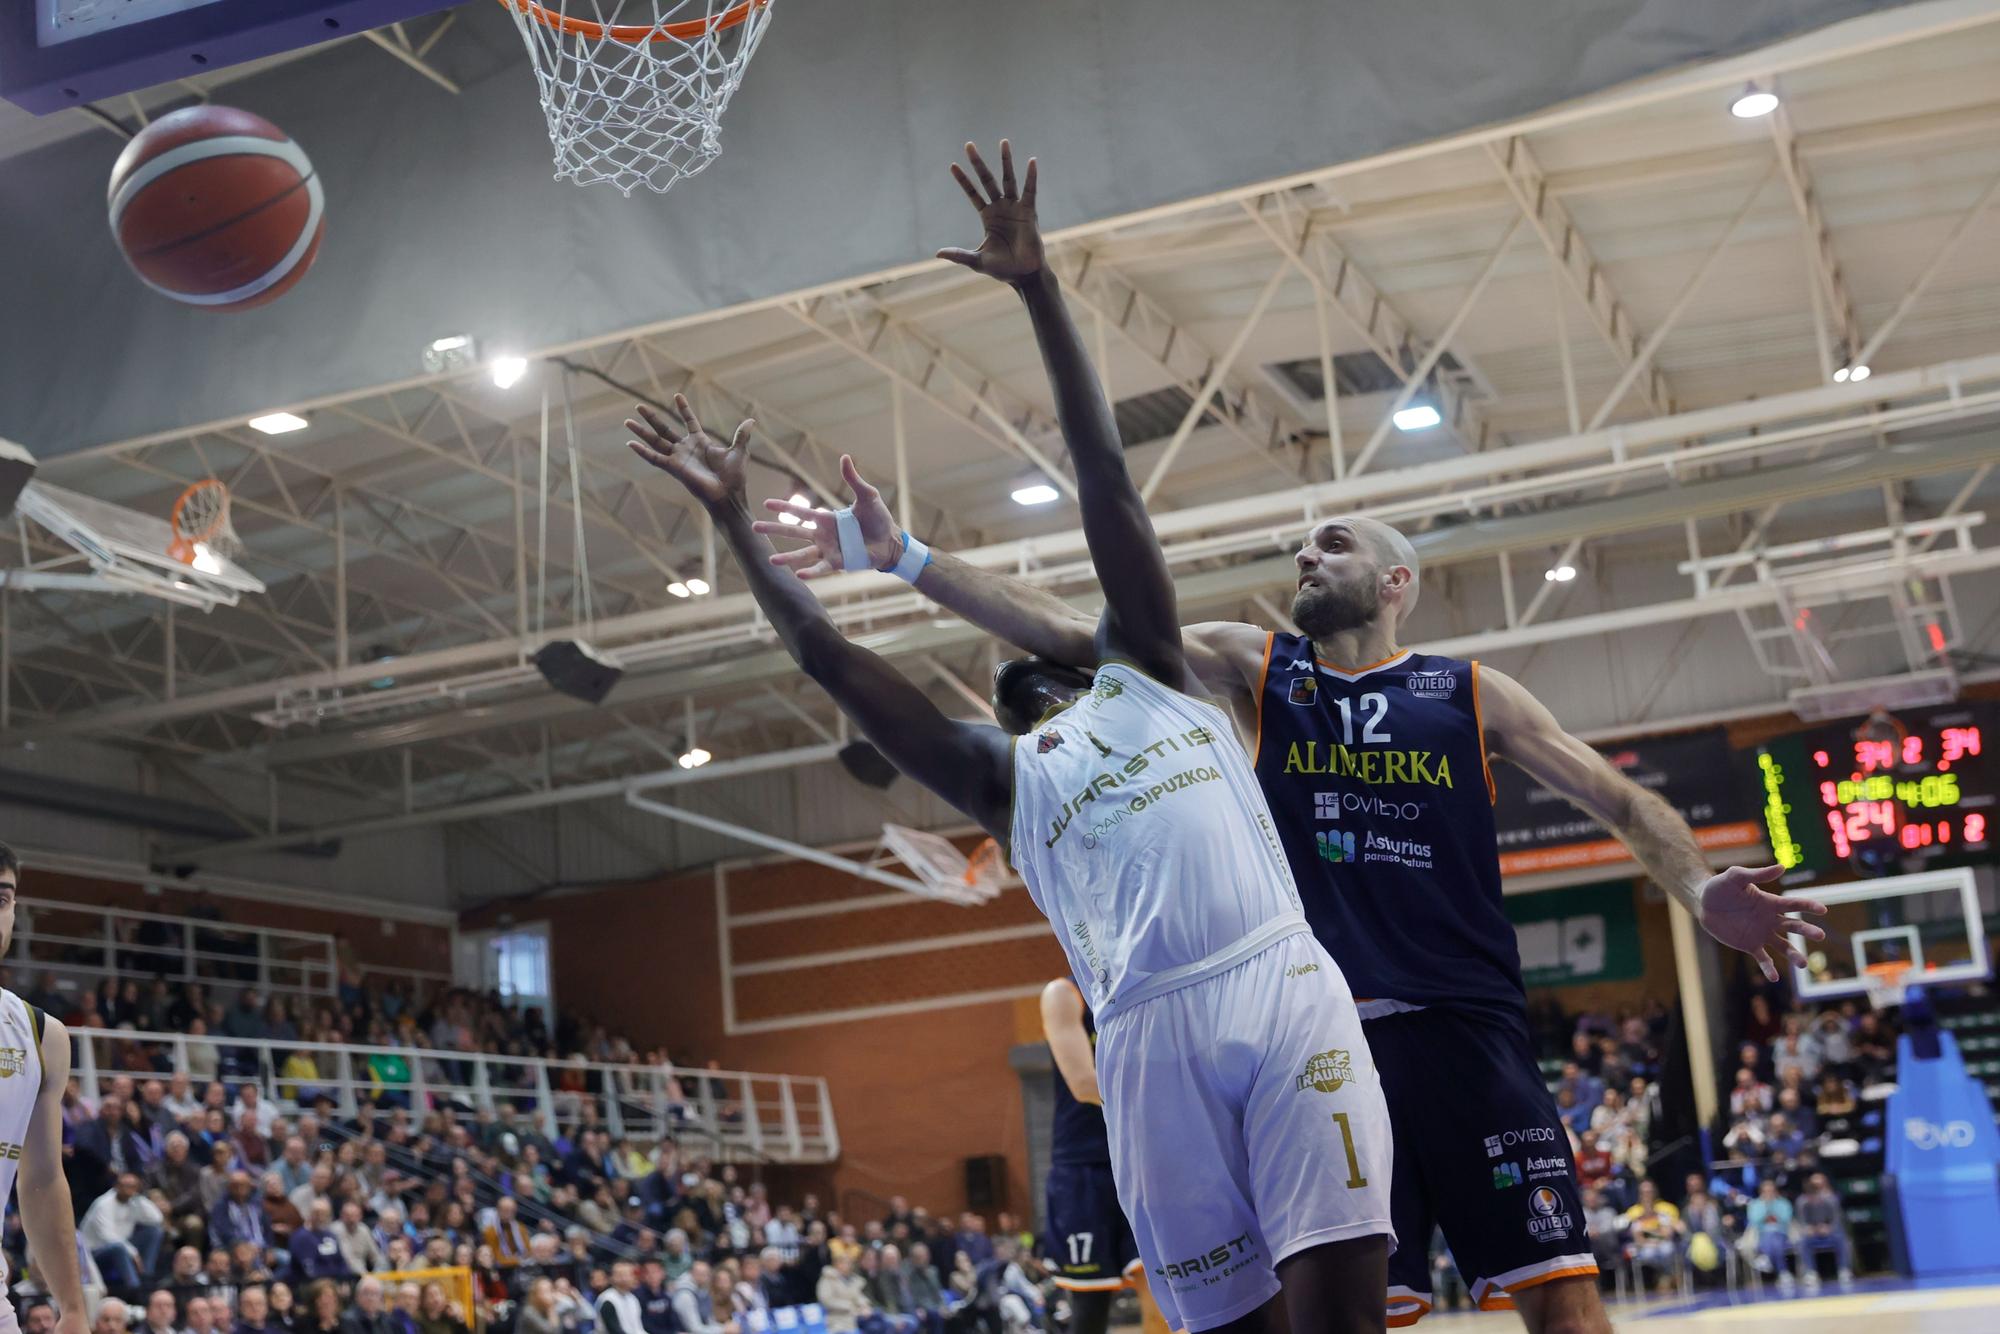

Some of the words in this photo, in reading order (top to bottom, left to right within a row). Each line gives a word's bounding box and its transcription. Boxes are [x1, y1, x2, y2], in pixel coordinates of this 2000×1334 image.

[1408, 677, 1454, 690] OVIEDO
[1334, 692, 1391, 745] 12
[1283, 741, 1453, 789] ALIMERKA
[1045, 737, 1180, 848] JUARISTI
[1845, 800, 1896, 841] 24
[1364, 830, 1431, 857] Asturias
[1296, 1067, 1355, 1092] IRAURGI
[1332, 1112, 1368, 1189] 1
[1503, 1128, 1555, 1146] OVIEDO
[1527, 1155, 1566, 1171] Asturias
[1529, 1215, 1572, 1233] OVIEDO
[1066, 1232, 1093, 1264] 17
